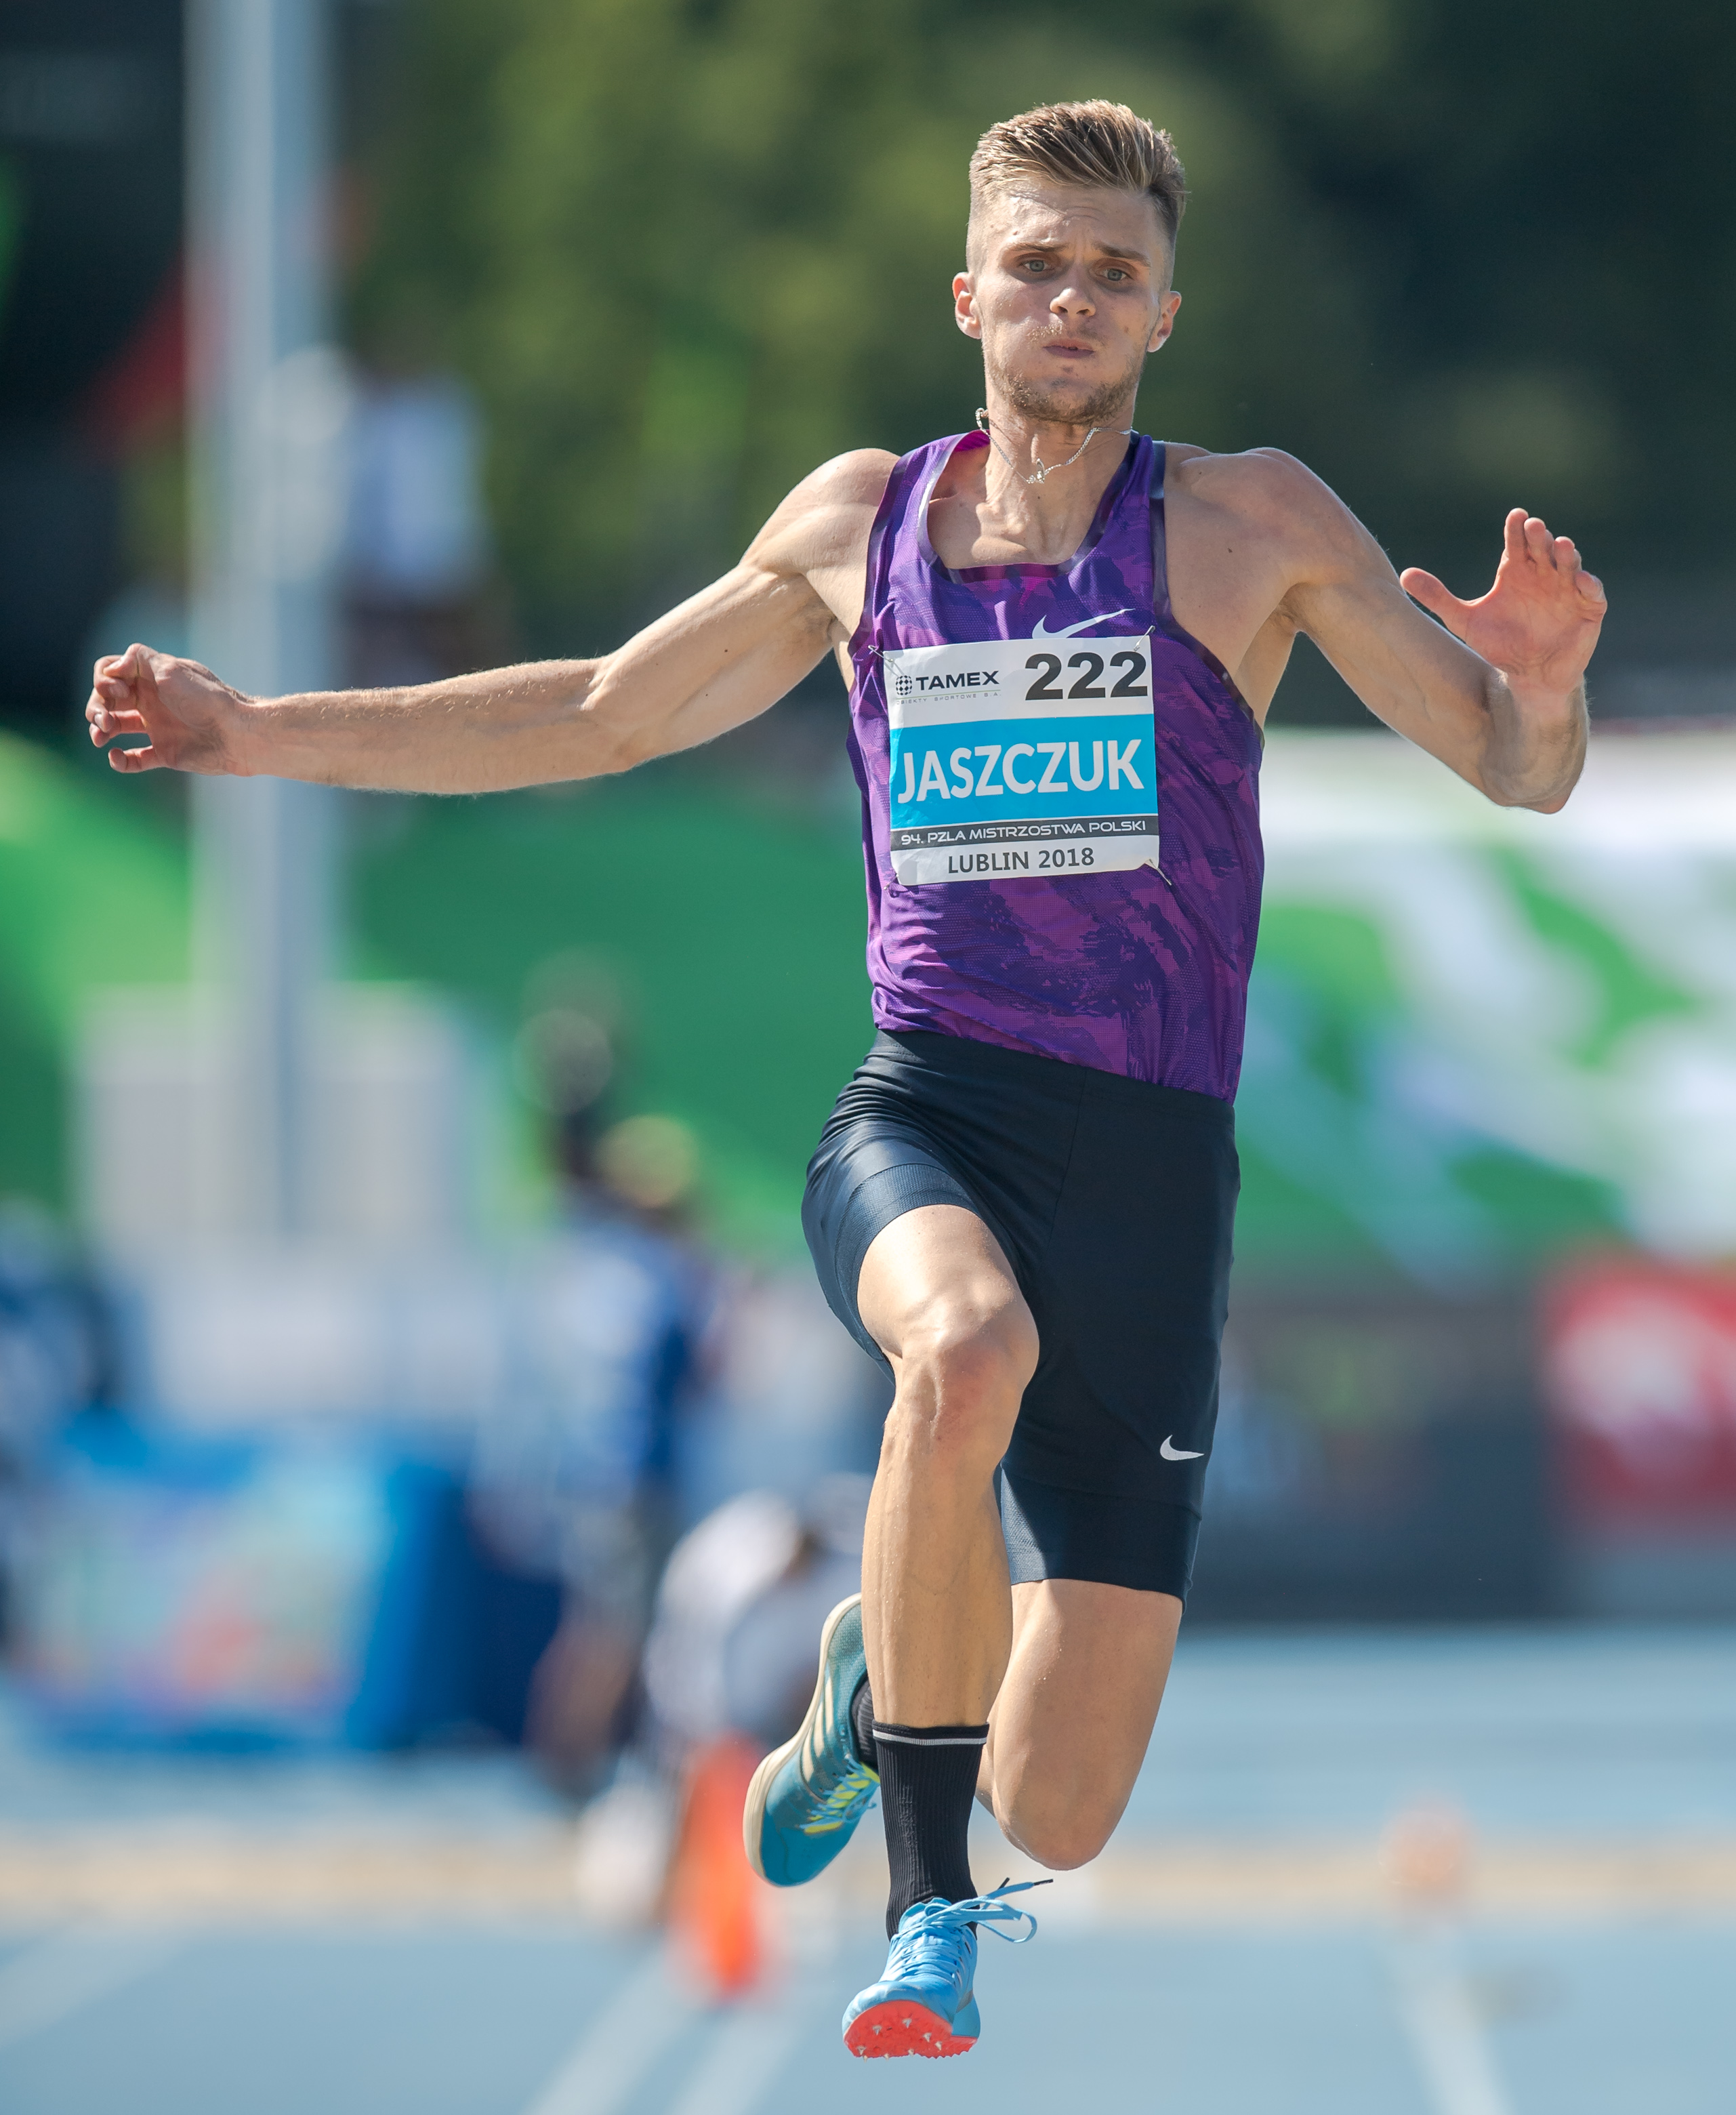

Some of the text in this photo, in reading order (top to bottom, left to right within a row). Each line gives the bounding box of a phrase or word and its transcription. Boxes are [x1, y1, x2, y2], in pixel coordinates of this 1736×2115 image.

[916, 671, 999, 691] TAMEX
[1025, 651, 1148, 701] 222
[897, 739, 1144, 804] JASZCZUK
[901, 821, 1146, 845] 94. PZLA MISTRZOSTWA POLSKI
[948, 848, 1094, 874] LUBLIN 2018
